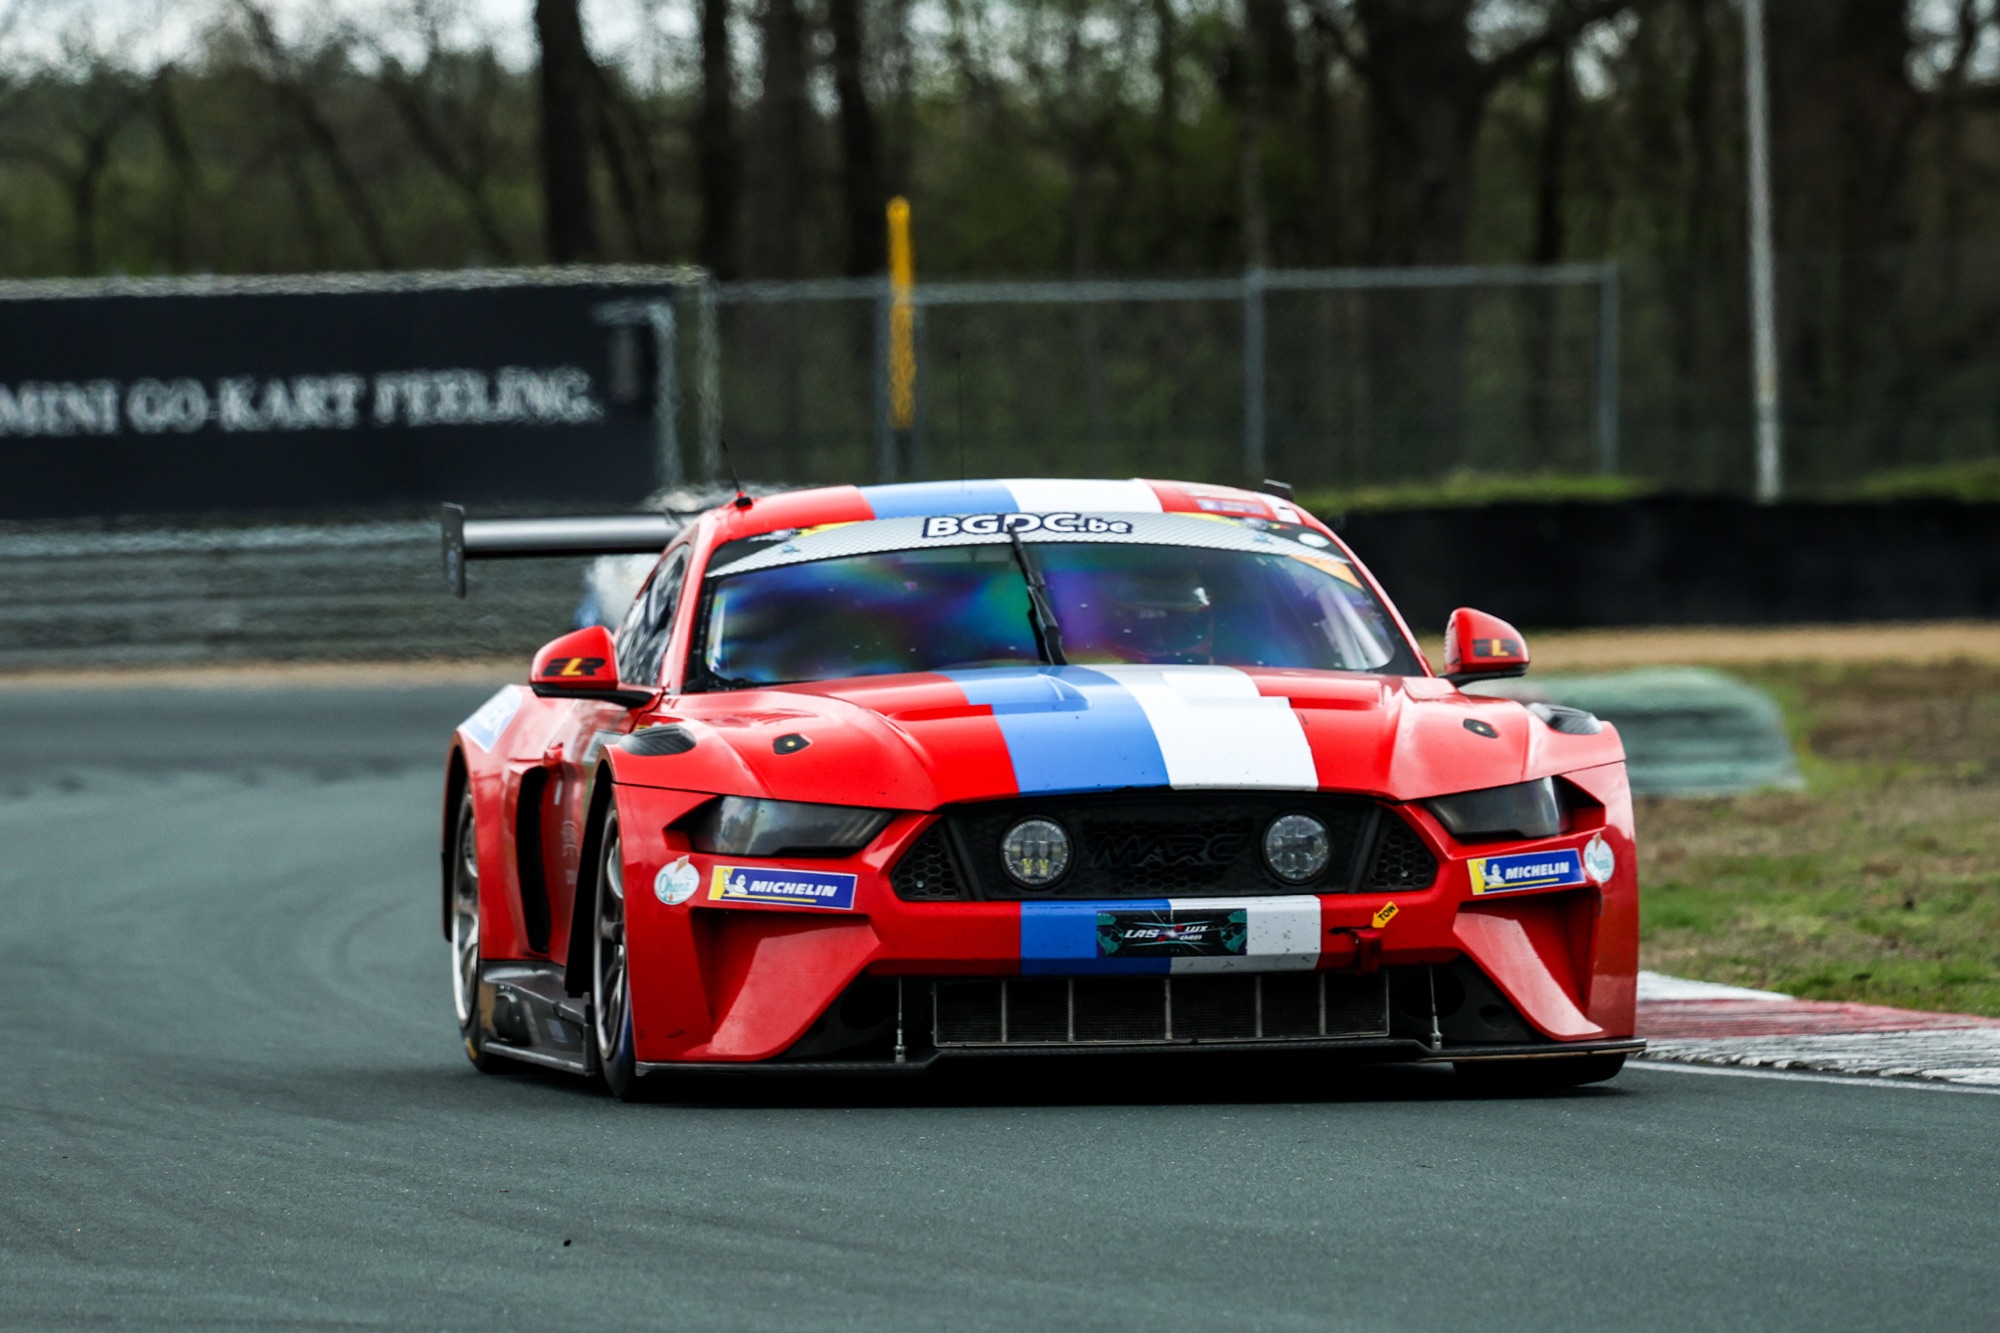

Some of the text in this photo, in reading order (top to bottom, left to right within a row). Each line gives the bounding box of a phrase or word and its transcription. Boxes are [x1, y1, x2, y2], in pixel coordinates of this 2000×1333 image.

[922, 512, 1133, 538] BGDC.be
[542, 657, 605, 677] ELR
[1089, 834, 1244, 867] MARC
[1505, 861, 1570, 880] MICHELIN
[750, 880, 838, 897] MICHELIN
[1377, 904, 1396, 921] TOW
